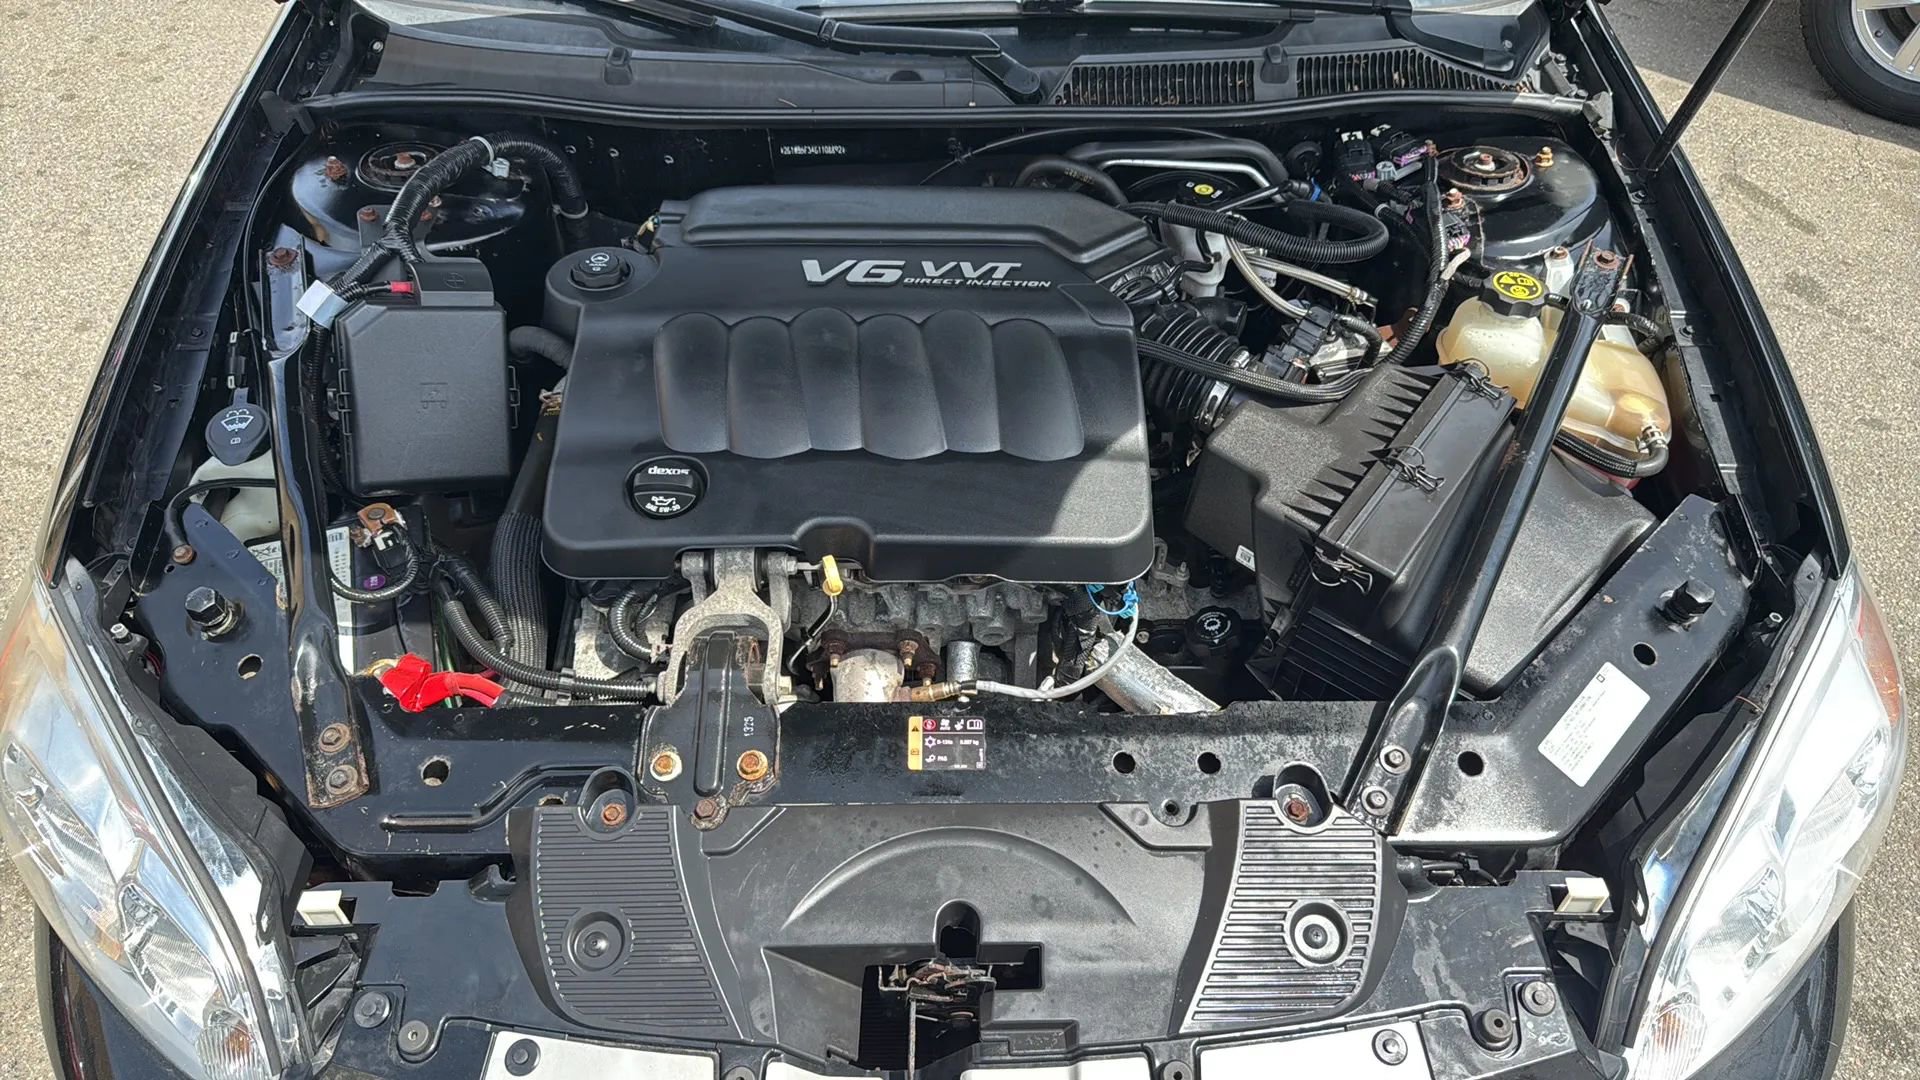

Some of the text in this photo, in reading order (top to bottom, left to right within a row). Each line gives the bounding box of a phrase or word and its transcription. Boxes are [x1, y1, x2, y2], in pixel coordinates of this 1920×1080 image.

[801, 260, 1023, 284] V6 VVT
[903, 277, 1052, 288] DIRECT INJECTION
[647, 465, 691, 475] dexos
[743, 716, 754, 737] 1325
